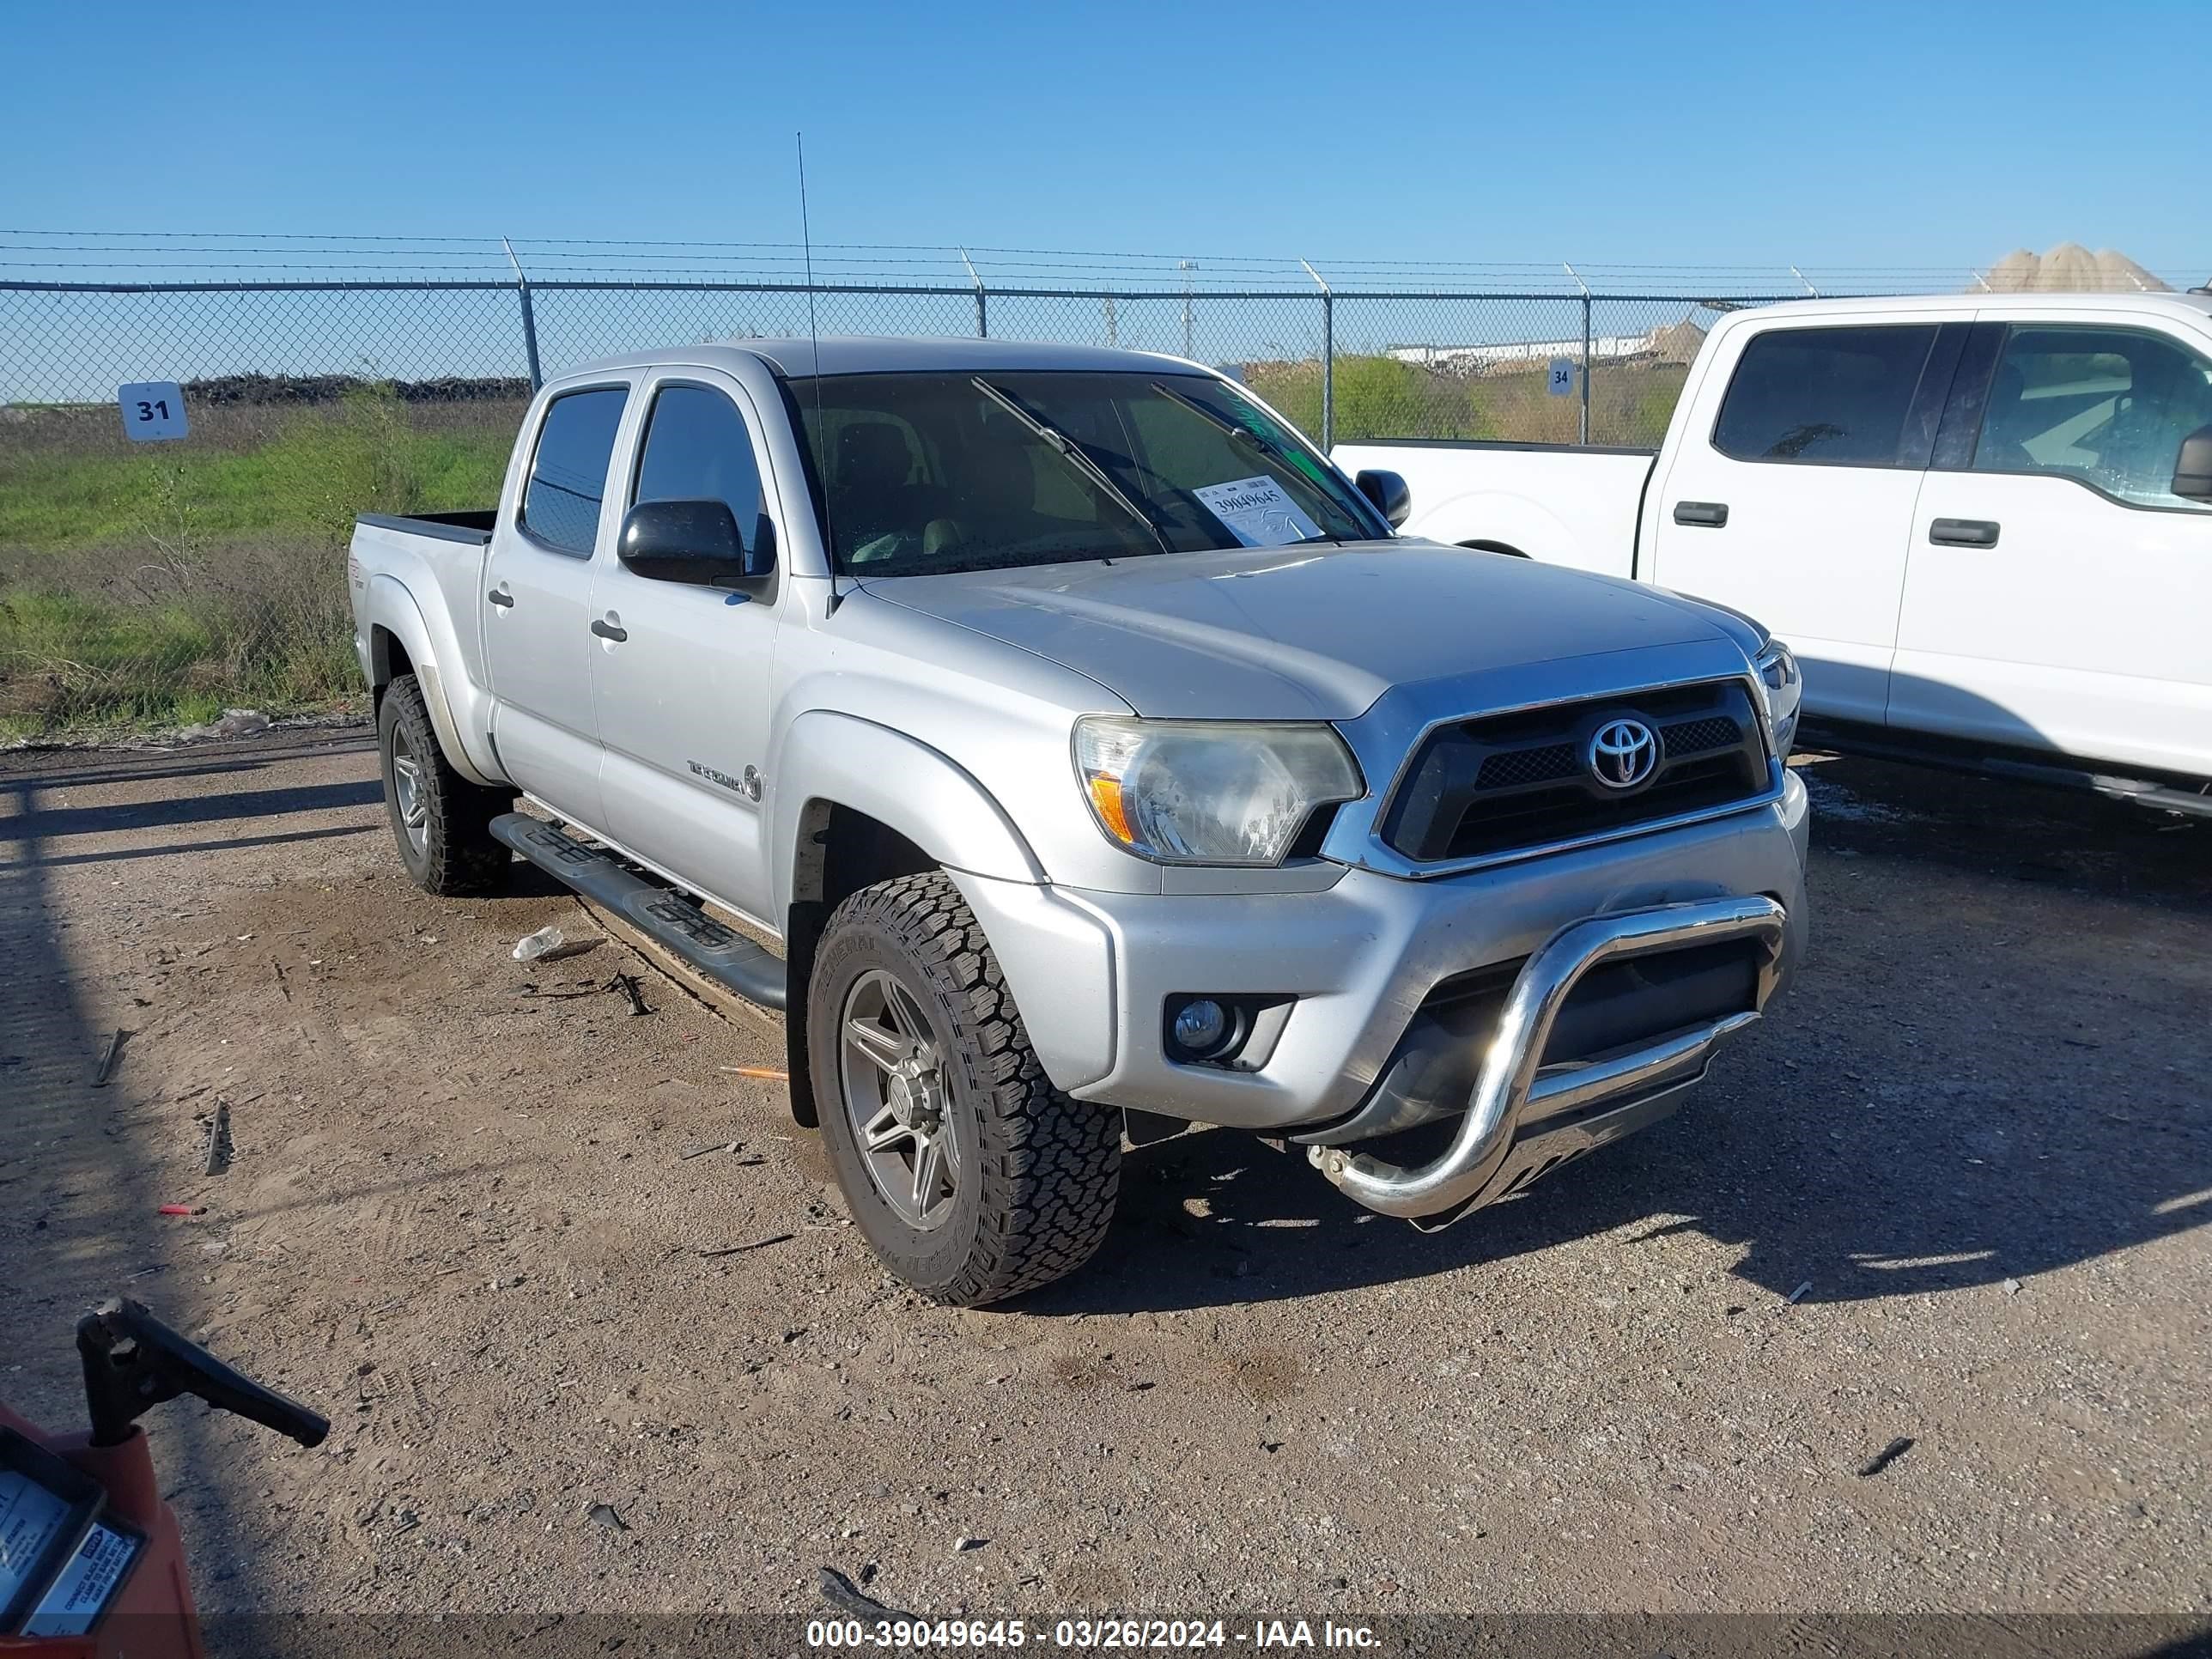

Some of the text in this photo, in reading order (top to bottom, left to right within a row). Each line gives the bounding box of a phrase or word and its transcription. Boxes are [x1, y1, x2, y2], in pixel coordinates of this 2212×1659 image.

[1555, 371, 1567, 384] 34
[137, 400, 169, 422] 31
[1214, 490, 1280, 513] 39049645
[817, 934, 881, 1003] GENERAL
[906, 1201, 969, 1273] GRABBER
